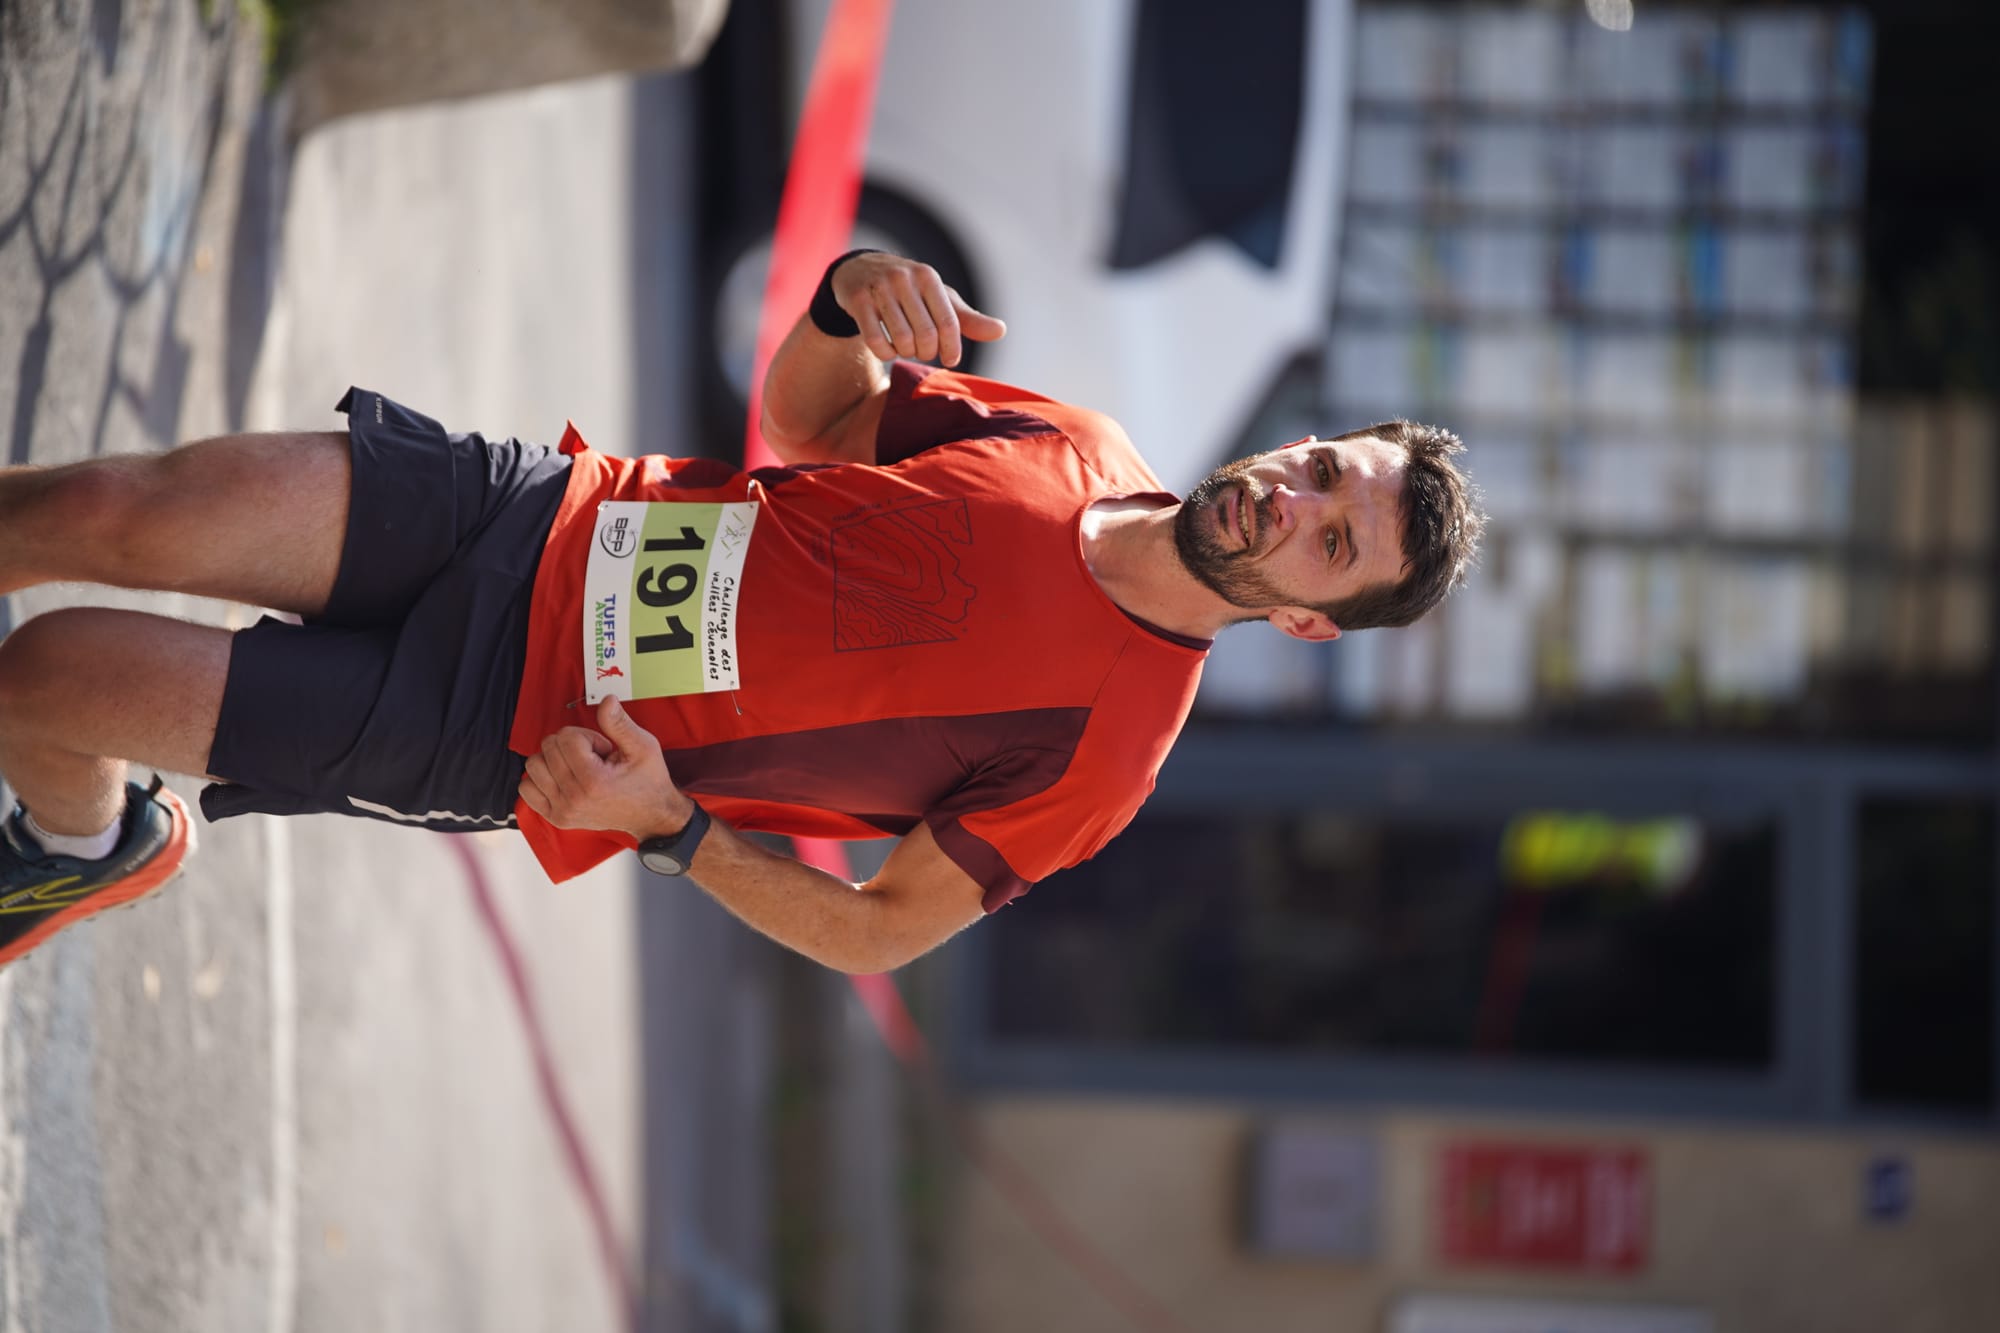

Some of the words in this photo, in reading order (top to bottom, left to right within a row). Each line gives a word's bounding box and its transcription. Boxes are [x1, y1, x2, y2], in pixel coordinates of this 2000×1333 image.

[611, 517, 629, 552] BFP
[635, 526, 706, 654] 191
[708, 571, 720, 613] vallées
[716, 577, 734, 640] Challenge
[595, 601, 607, 667] Aventure
[604, 593, 616, 659] TUFF'S
[707, 620, 719, 680] cévenoles
[721, 648, 731, 672] des
